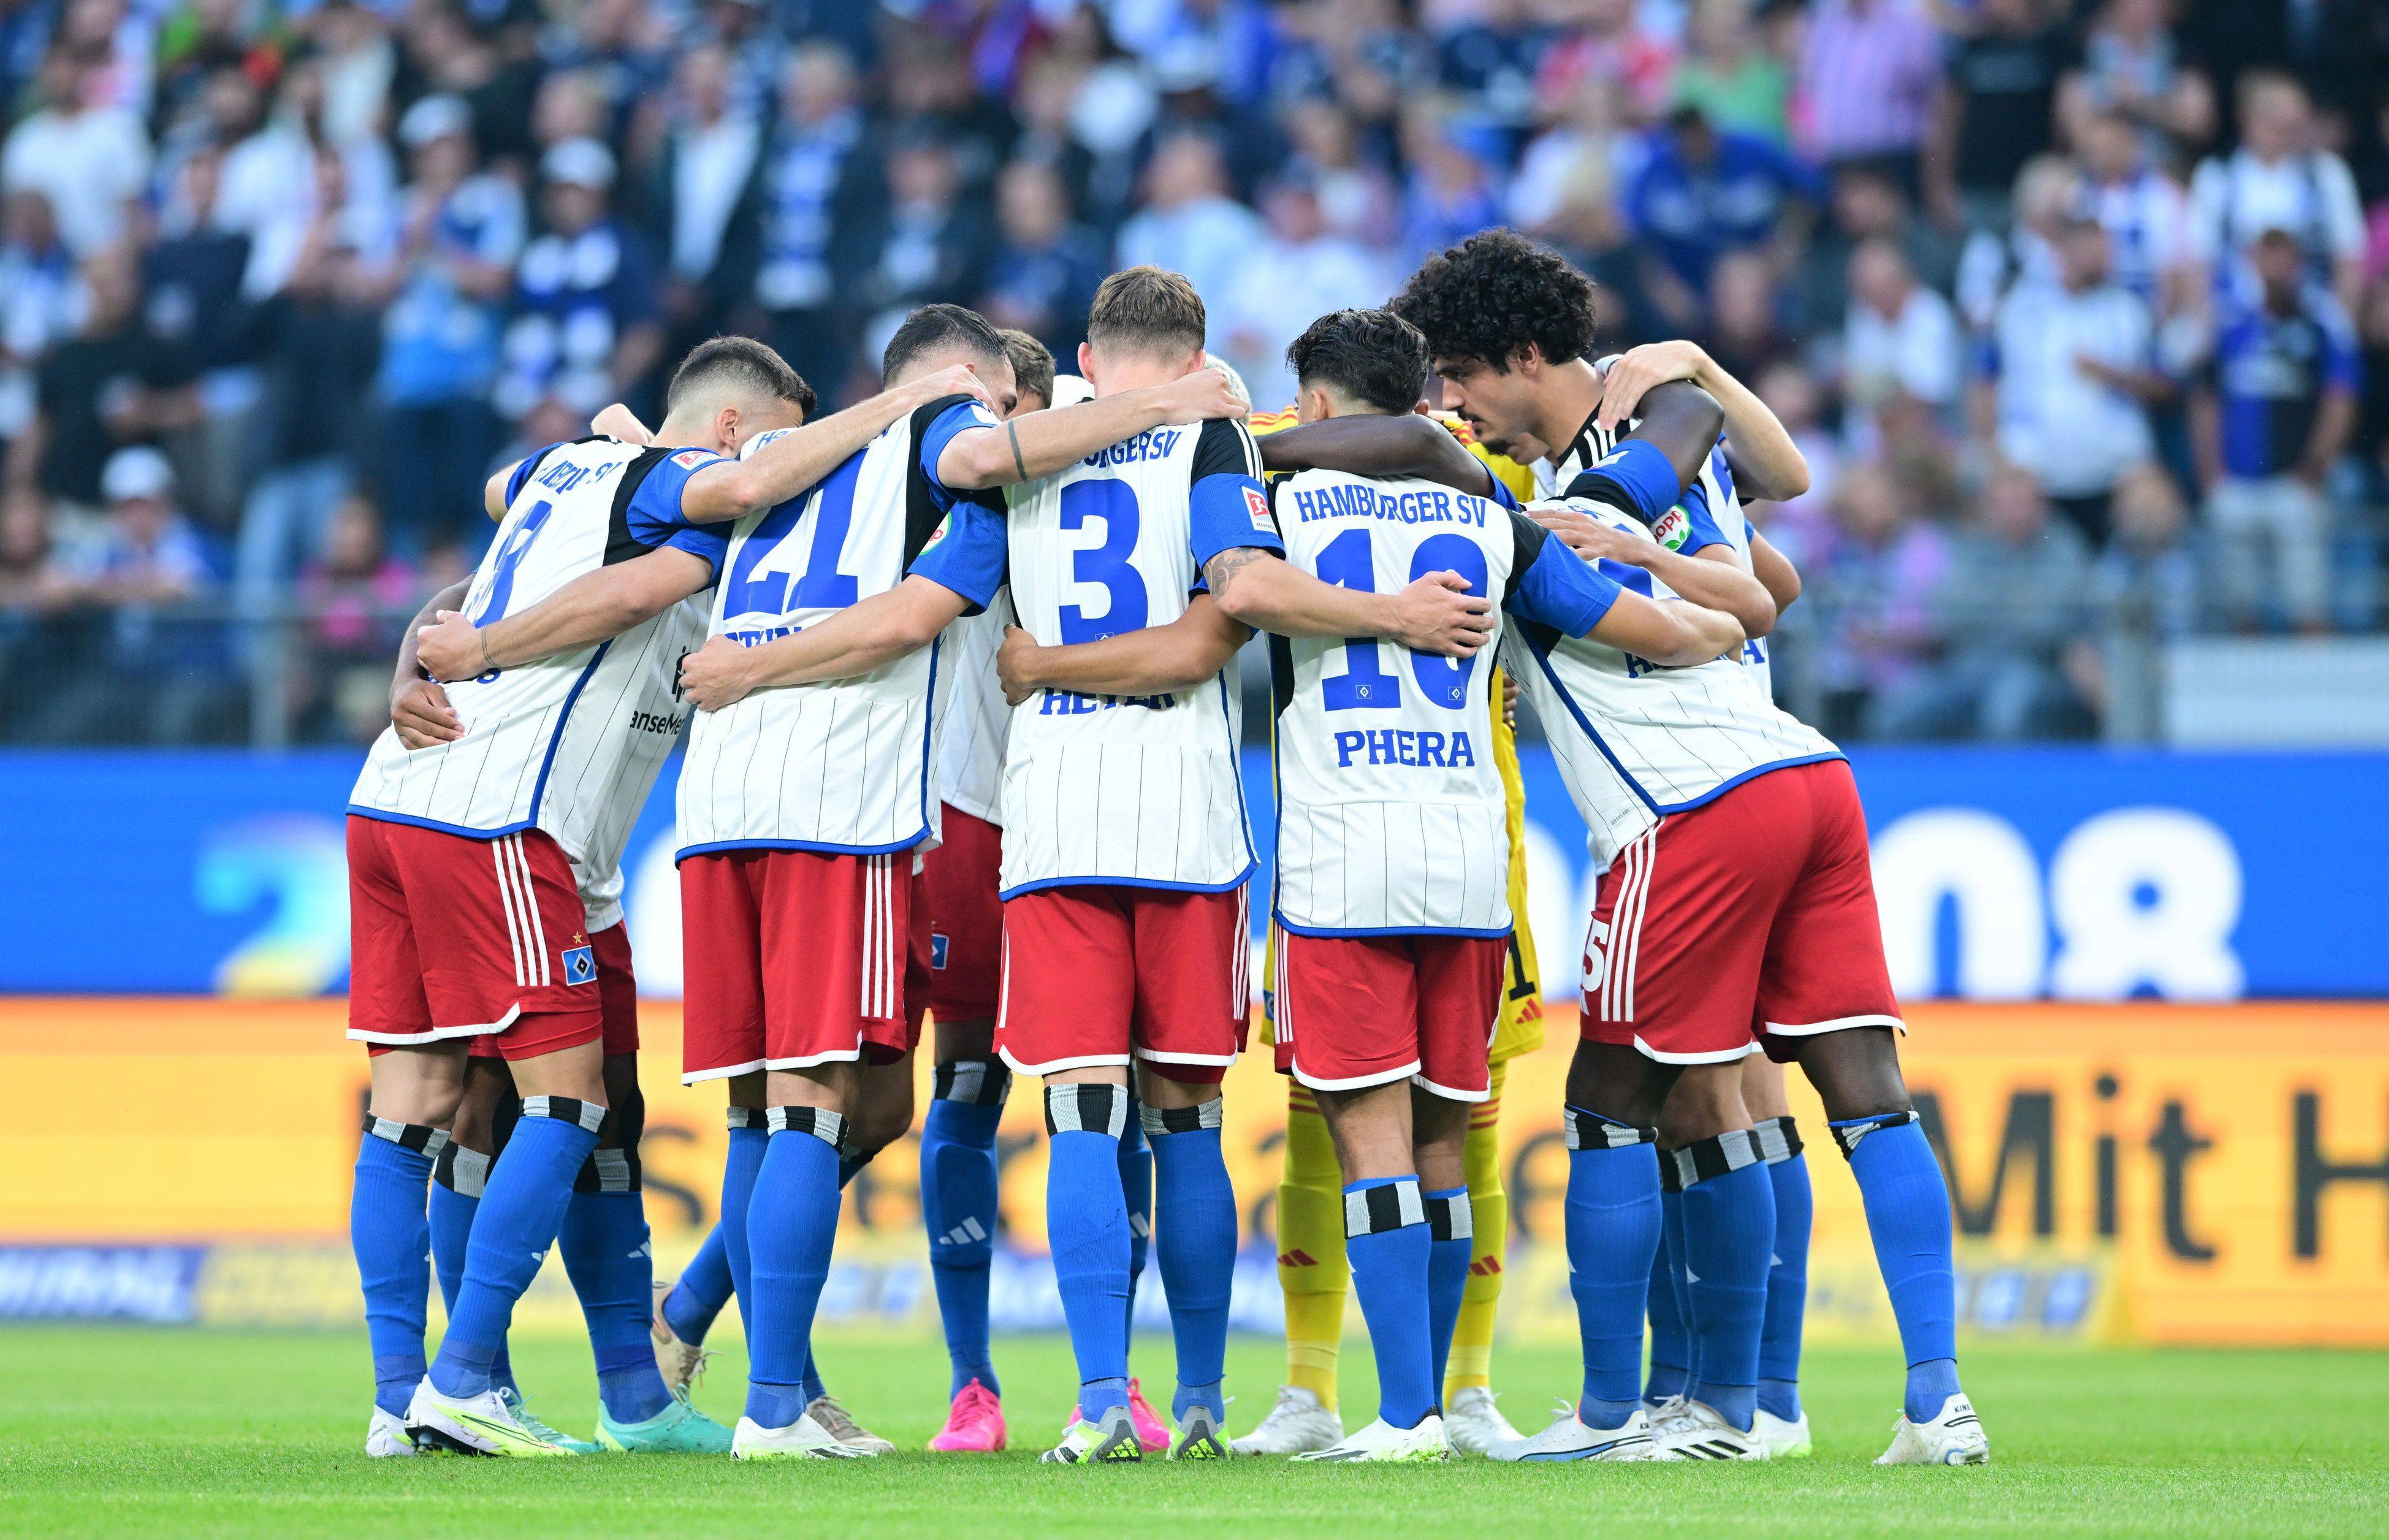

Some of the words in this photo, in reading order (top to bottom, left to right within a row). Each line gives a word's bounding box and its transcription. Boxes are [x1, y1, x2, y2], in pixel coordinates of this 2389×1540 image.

[1149, 430, 1183, 460] SV
[723, 448, 869, 620] 21
[1294, 484, 1452, 524] HAMBURGER
[1458, 495, 1487, 528] SV
[1059, 478, 1149, 645] 3
[1335, 728, 1475, 768] PHERA
[1509, 930, 1536, 1001] 1
[1582, 918, 1610, 992] 5
[1909, 1074, 2216, 1259] Mit
